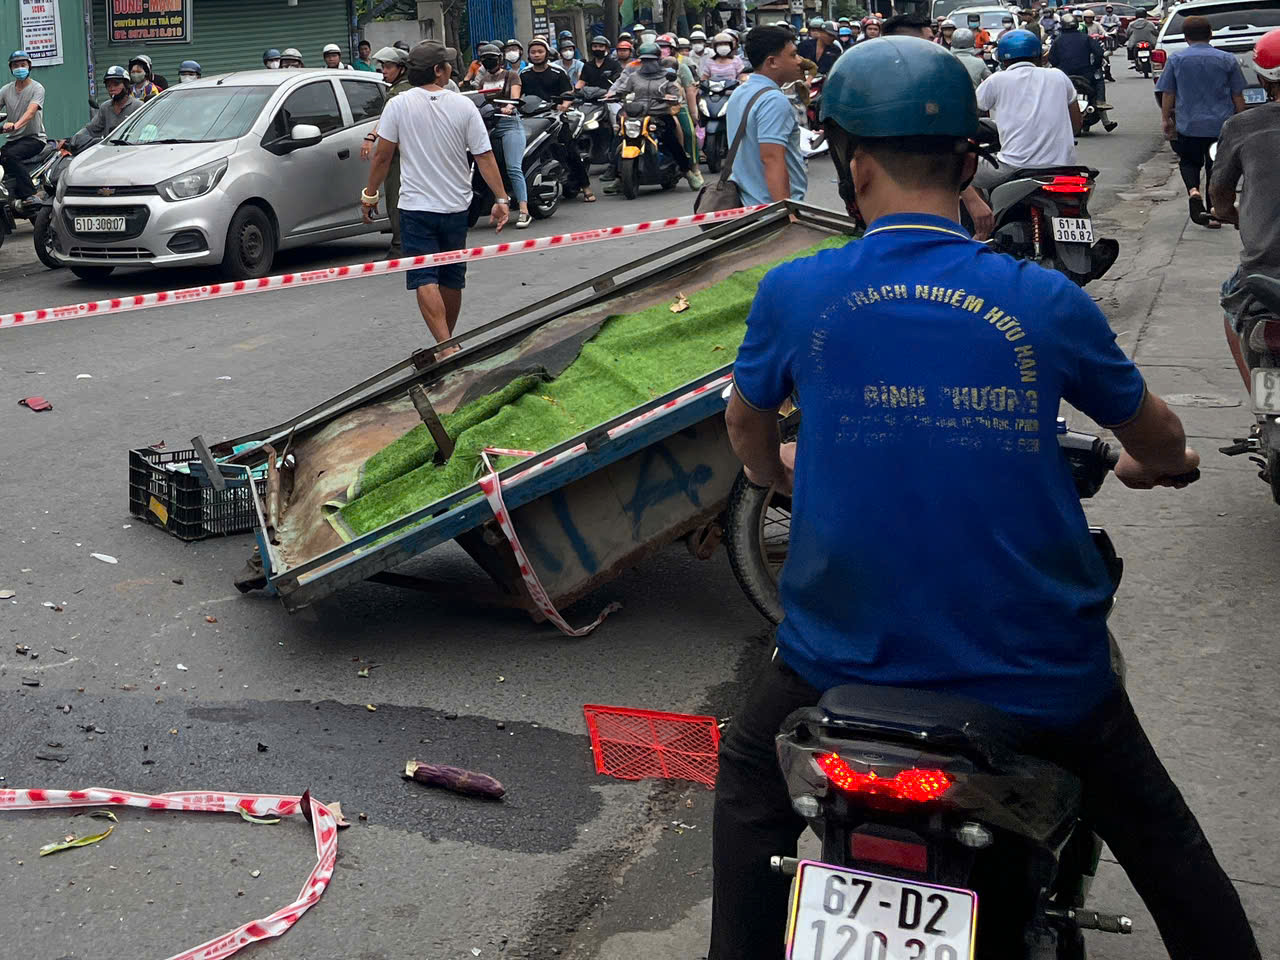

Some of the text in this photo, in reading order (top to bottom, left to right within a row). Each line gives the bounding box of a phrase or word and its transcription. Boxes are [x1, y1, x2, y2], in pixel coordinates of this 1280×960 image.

[1056, 230, 1092, 241] 306.82
[1059, 218, 1087, 230] 61-AA
[915, 284, 985, 314] NHIỆM
[983, 306, 1026, 342] HỮU
[1013, 344, 1037, 383] HẠN
[822, 874, 950, 937] 67-D2
